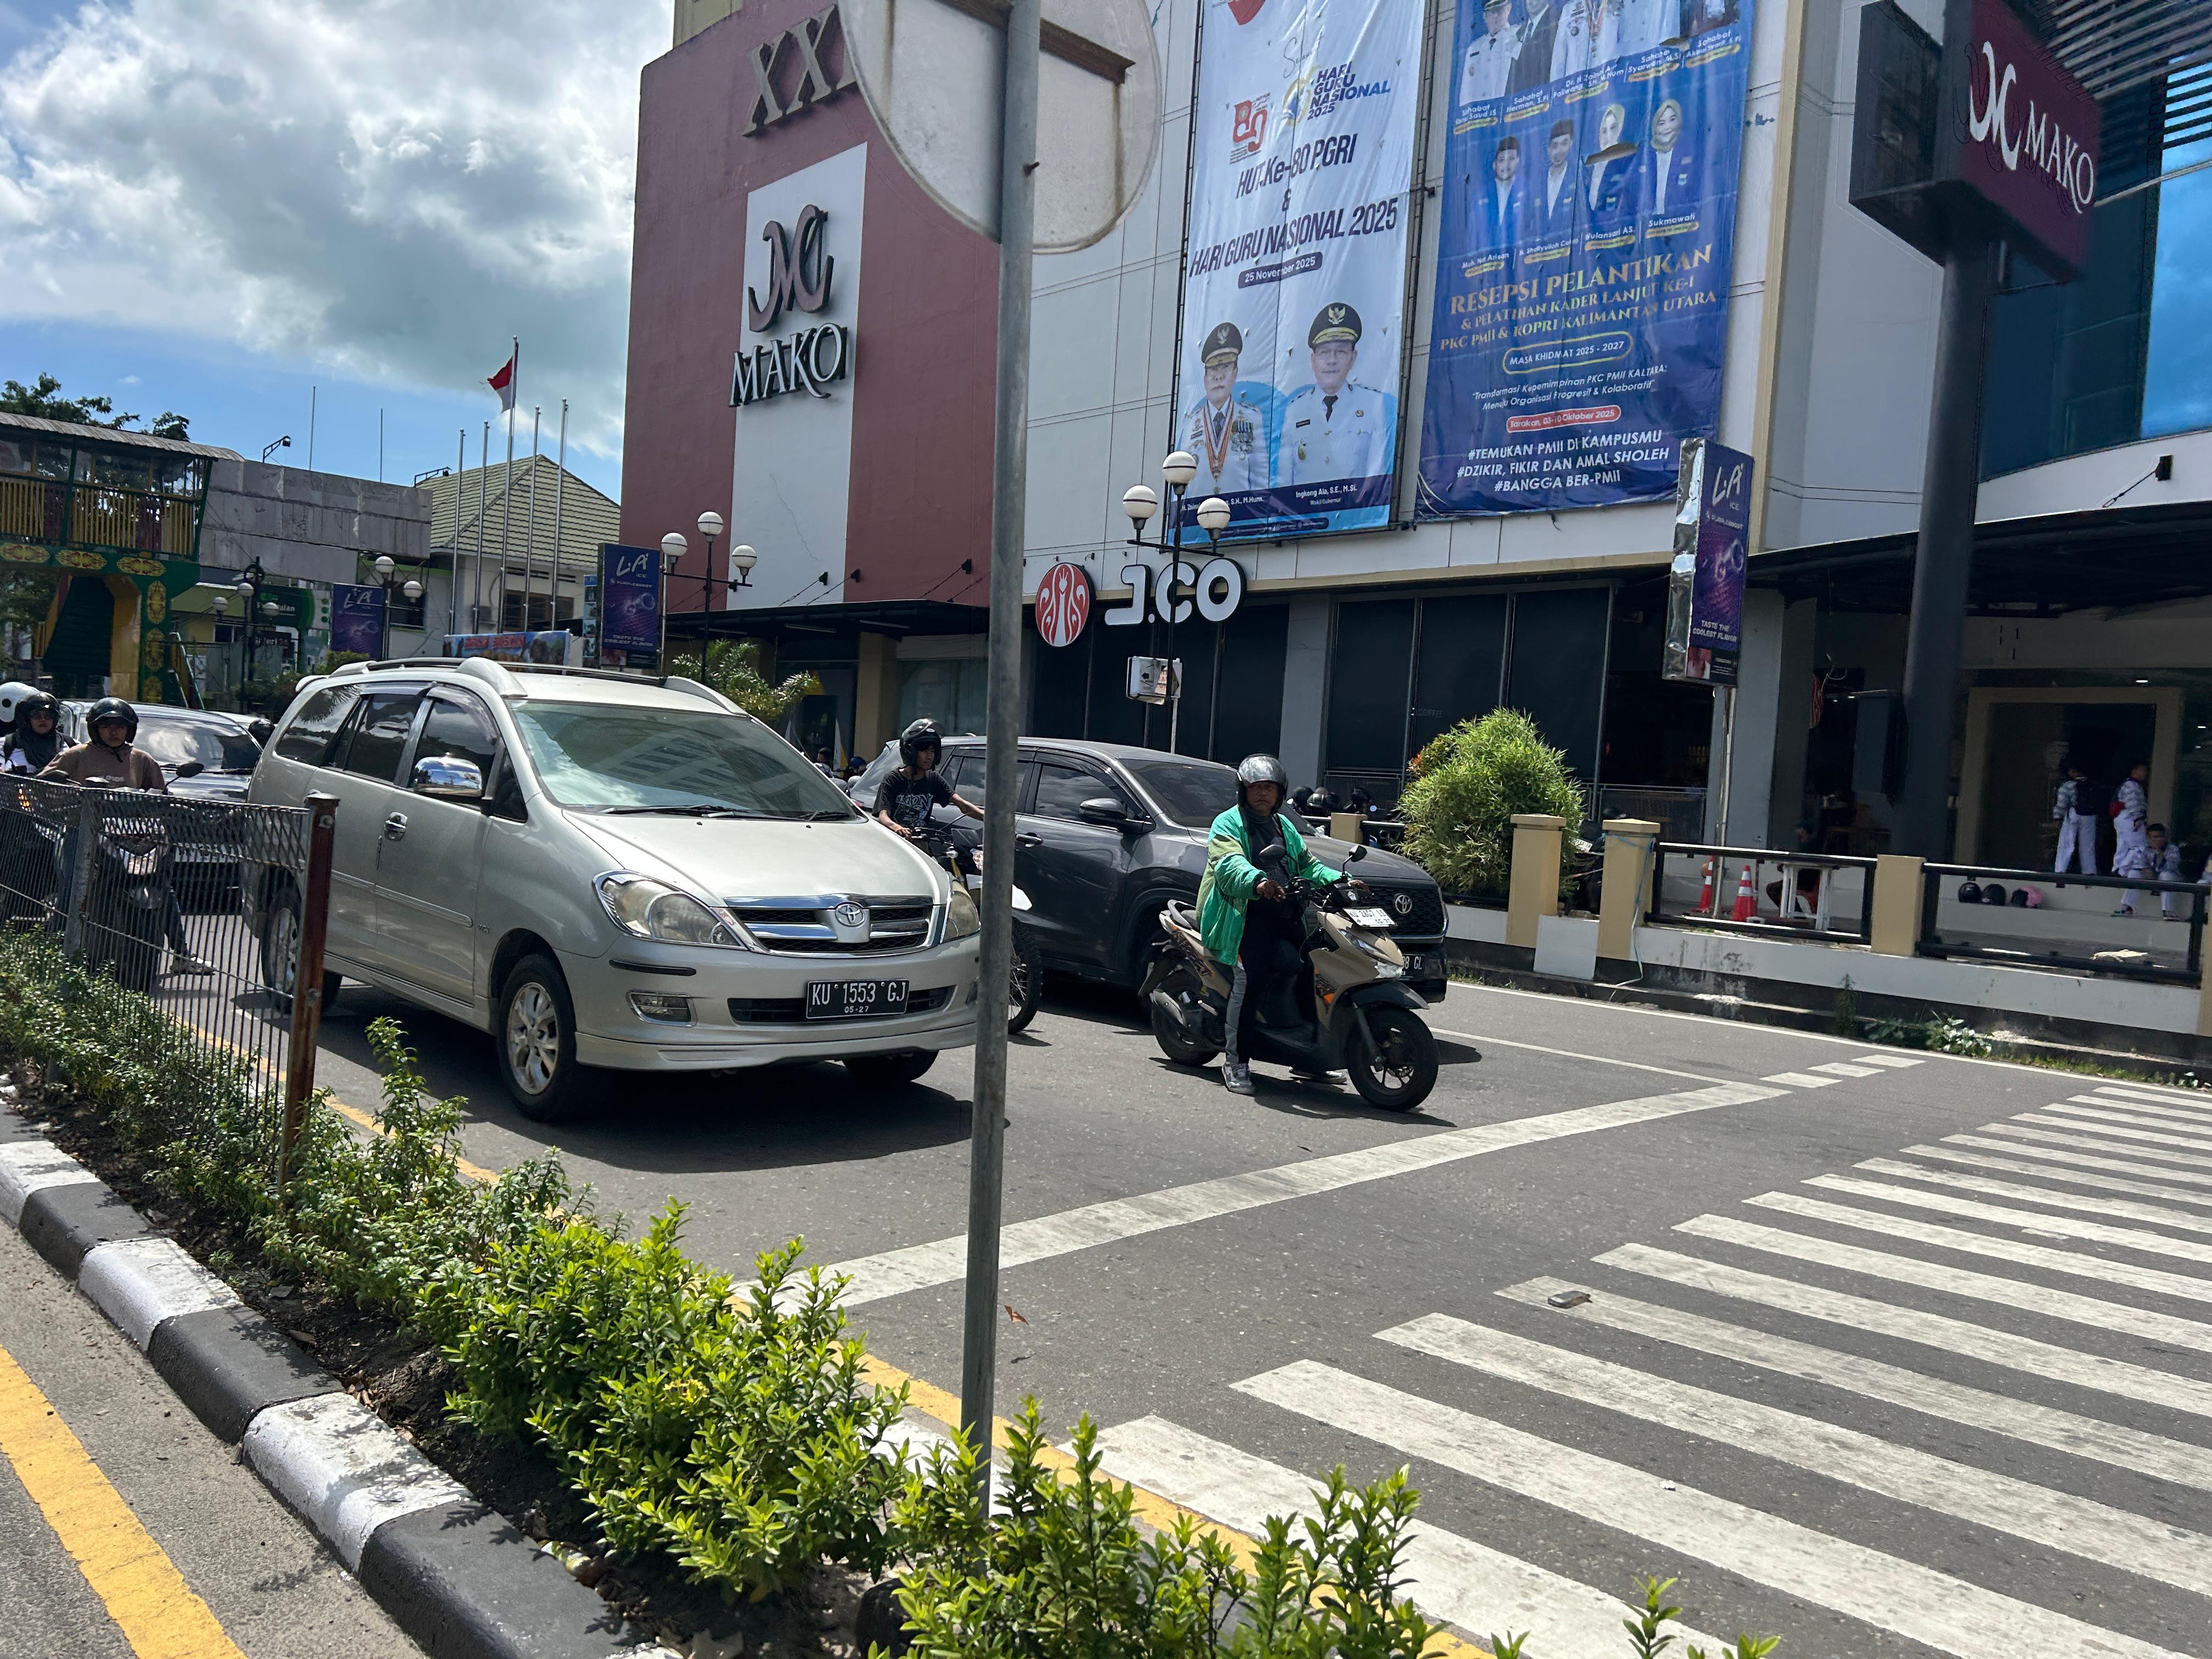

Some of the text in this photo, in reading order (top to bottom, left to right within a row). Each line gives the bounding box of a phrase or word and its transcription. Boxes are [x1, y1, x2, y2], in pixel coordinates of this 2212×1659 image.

[741, 3, 856, 138] XX
[1317, 61, 1352, 83] HARI
[1310, 80, 1391, 109] NASIONAL
[1314, 74, 1356, 96] GURU
[1514, 89, 1543, 104] Sahabat
[1307, 103, 1335, 121] 2025
[1310, 133, 1358, 170] PGRI
[2024, 101, 2094, 214] MAKO
[1282, 189, 1292, 211] &
[1649, 213, 1695, 227] Sukmawati
[1189, 197, 1398, 277] HARI GURU NASIONAL 2025
[1487, 252, 1510, 261] Arisan
[1245, 256, 1316, 283] 25 November 2025
[1450, 243, 1712, 314] RESEPSI PELANTIKAN
[1461, 318, 1471, 330] &
[1475, 303, 1547, 328] PELATIHAN
[1550, 293, 1598, 313] KADER
[1602, 281, 1661, 303] LANJUT
[1440, 291, 1716, 350] PKC PMII & KOPRI KALIMANTAN UTARA
[728, 323, 847, 407] MAKO
[1509, 356, 1533, 365] MASA
[1535, 349, 1573, 362] KHIDMAT
[1575, 345, 1595, 357] 2025
[1601, 341, 1624, 352] 2027
[1522, 377, 1585, 393] Kepemimpinan
[1587, 373, 1605, 384] PKC
[1606, 370, 1626, 380] PMII
[1627, 363, 1667, 379] KALTARA:
[1482, 399, 1509, 411] Menuju
[1510, 391, 1551, 407] Organisasi
[1553, 387, 1592, 402] Progresif
[1510, 409, 1615, 428] Tarakan, 03-10 Oktober 2025
[1468, 430, 1663, 461] #TEMUKAN PMII DI KAMPUSMU
[1457, 447, 1669, 478] #DZIKIR, FIKIR DAN AMAL SHOLEH
[1494, 470, 1621, 492] #BANGGA BER-PMII
[1295, 490, 1317, 499] Ingkong
[1729, 501, 1739, 511] ICE
[1104, 557, 1245, 625] J.CO
[1692, 627, 1717, 638] COOLEST
[1701, 620, 1730, 632] TASTE THE
[812, 981, 906, 1006] KU 1553 GJ
